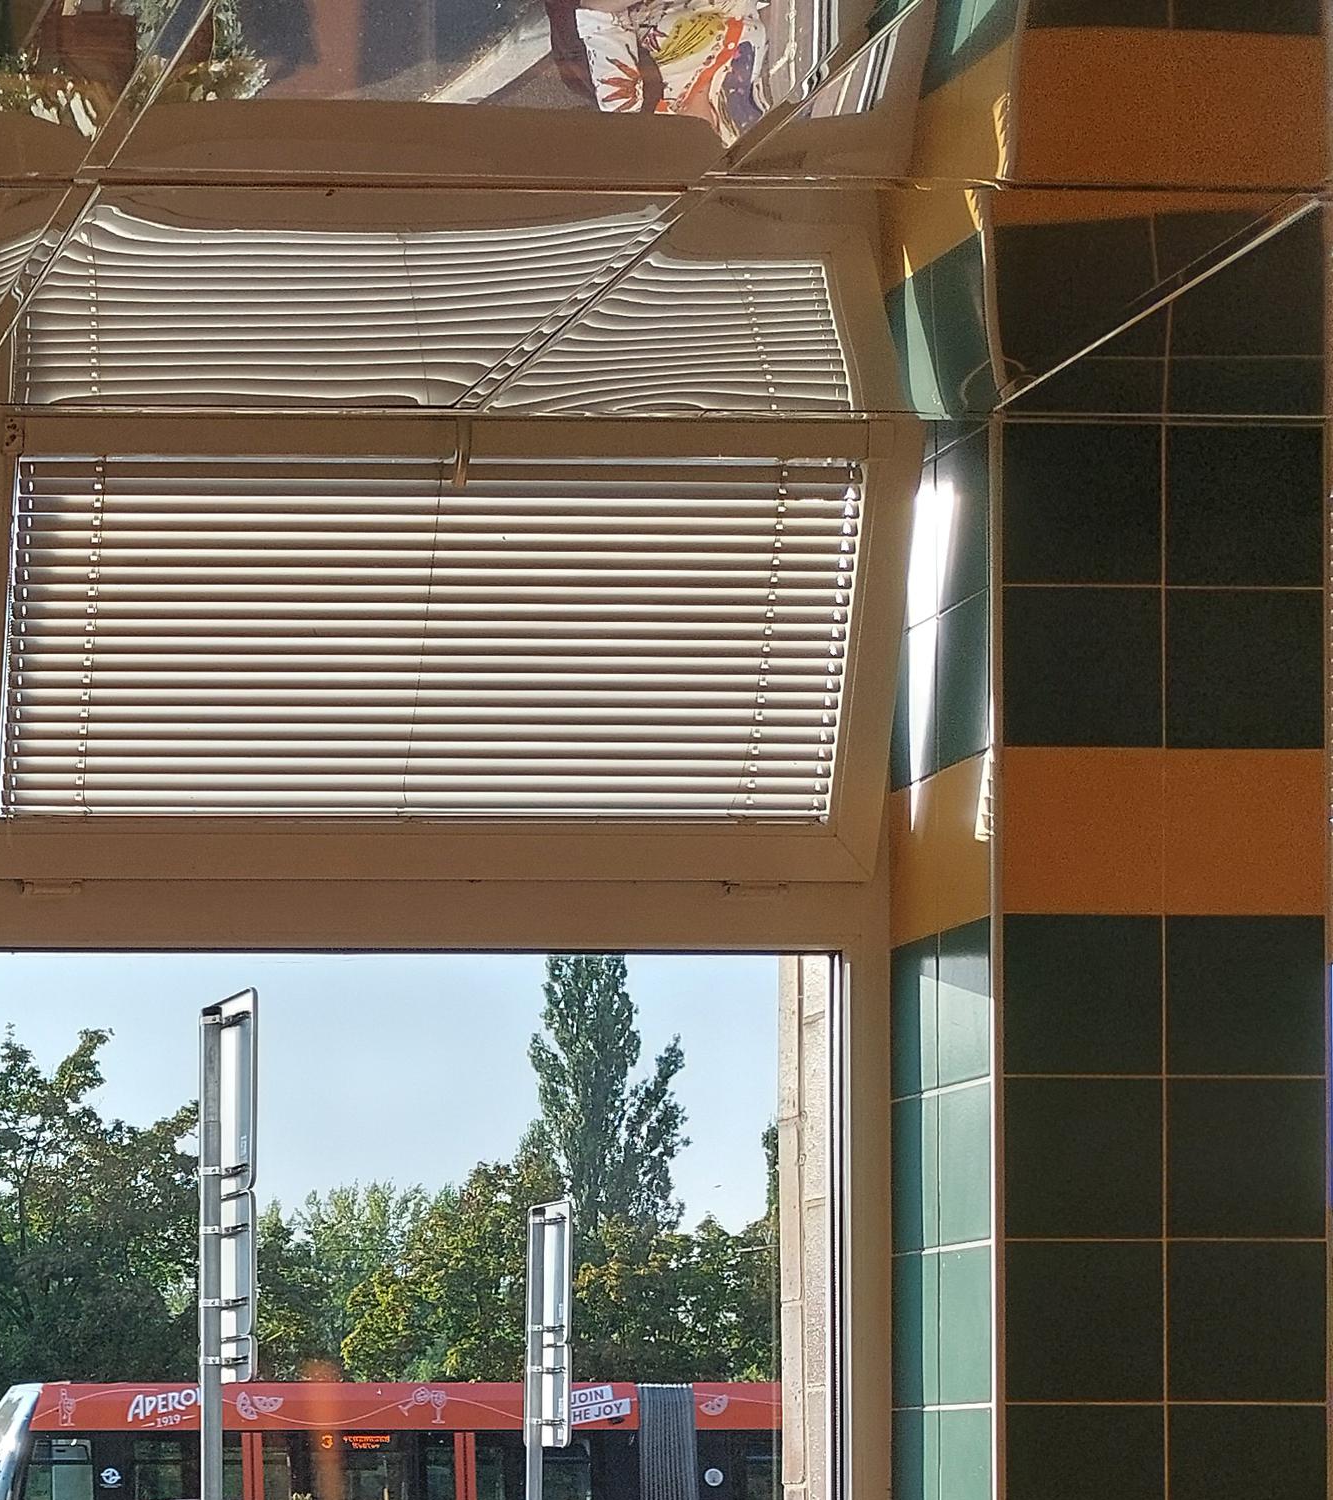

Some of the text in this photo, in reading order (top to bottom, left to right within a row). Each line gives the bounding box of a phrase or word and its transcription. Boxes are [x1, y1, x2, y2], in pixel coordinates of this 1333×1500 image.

[571, 1389, 604, 1405] JOIN
[573, 1402, 623, 1422] HE JOY
[156, 1414, 182, 1428] 1919
